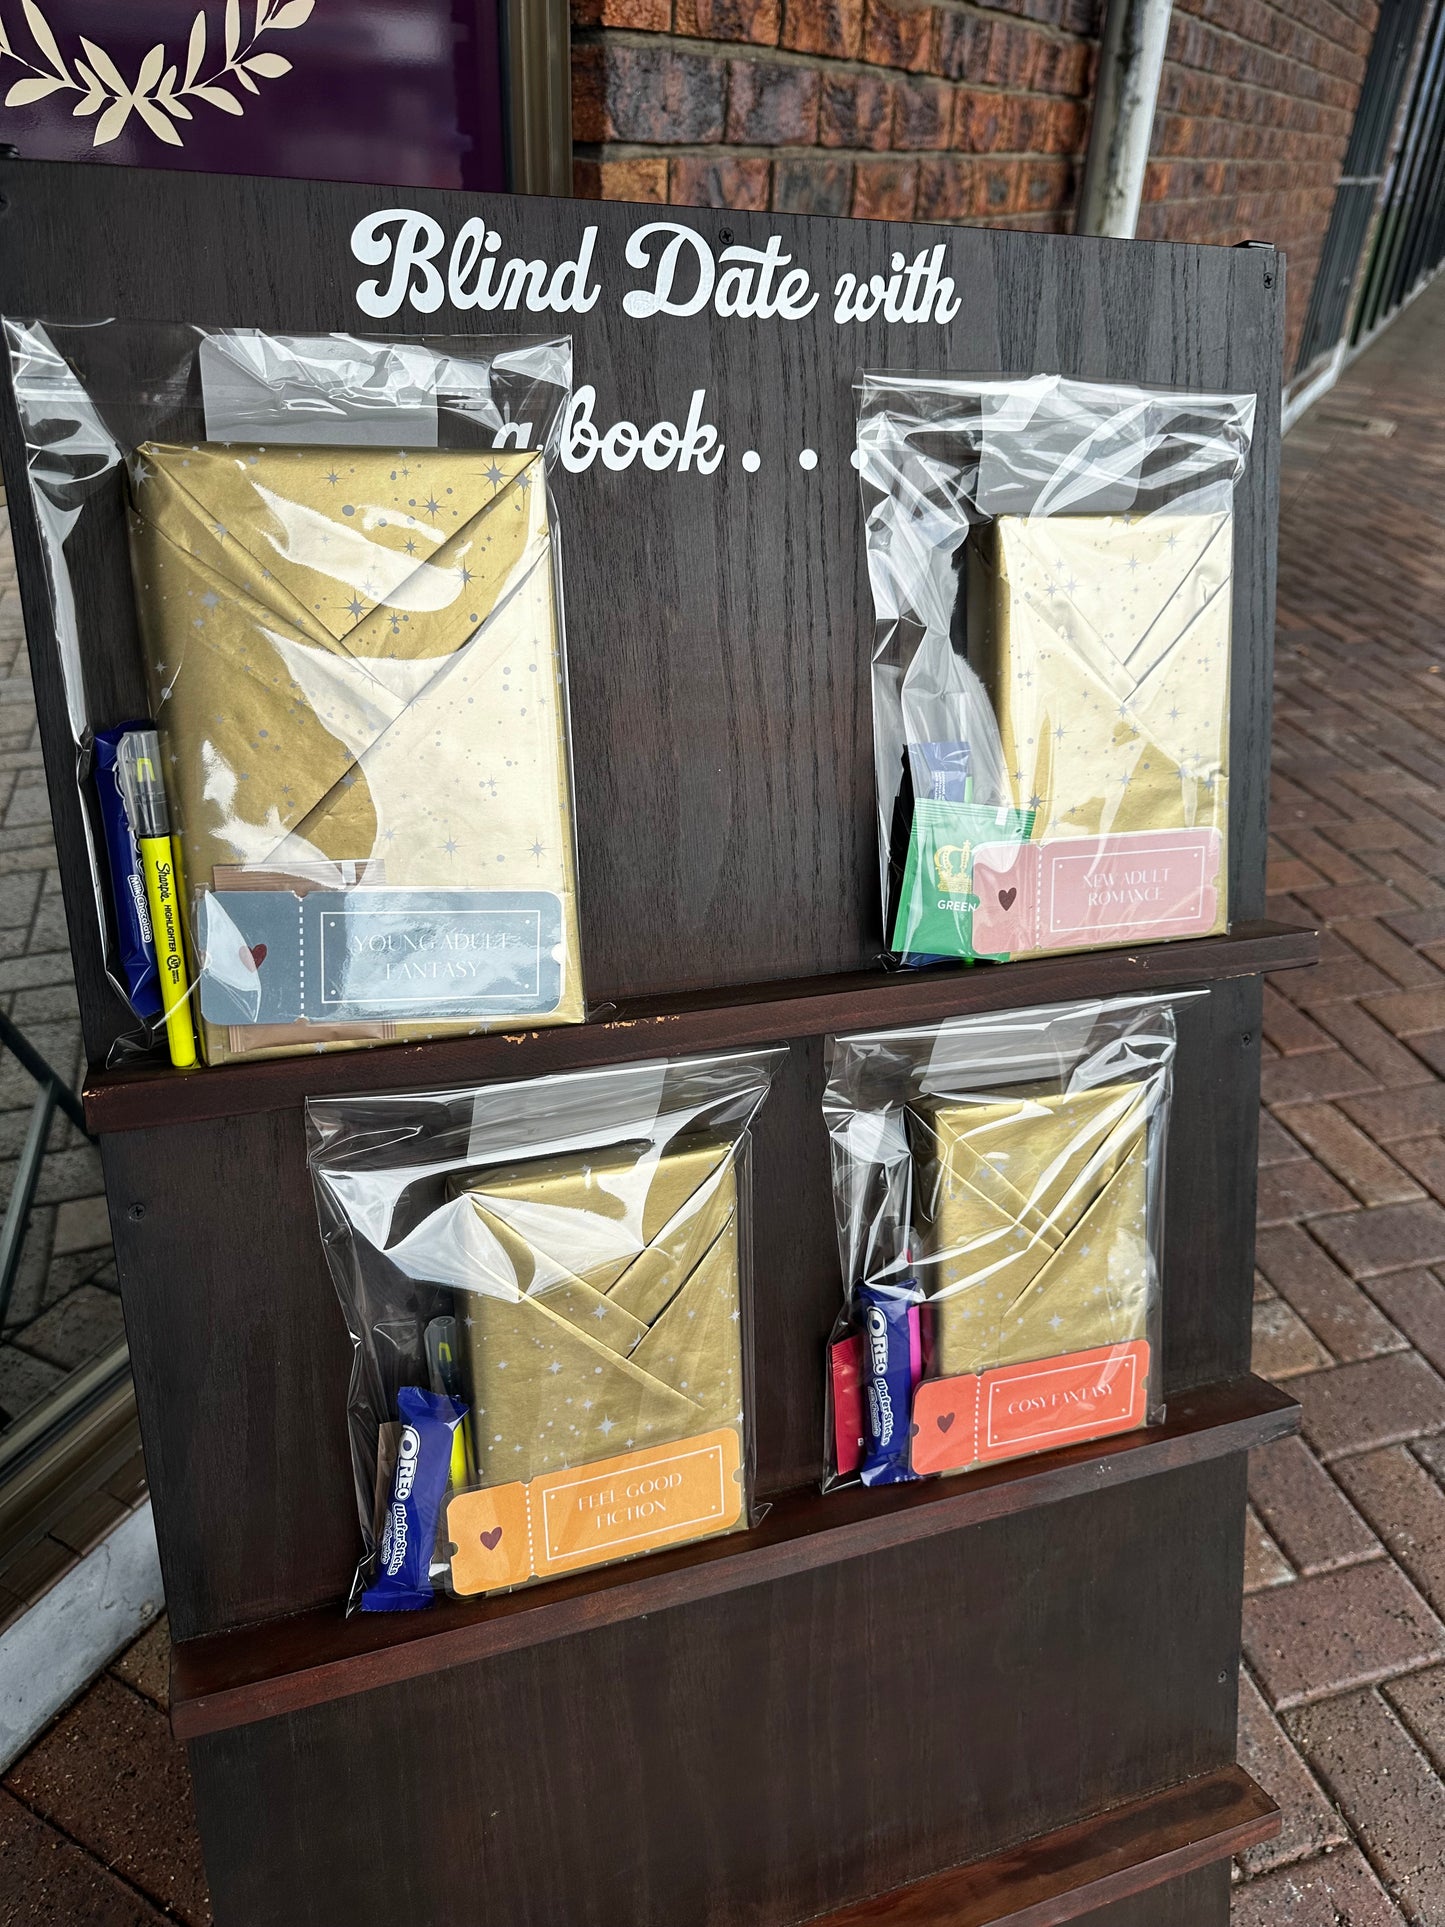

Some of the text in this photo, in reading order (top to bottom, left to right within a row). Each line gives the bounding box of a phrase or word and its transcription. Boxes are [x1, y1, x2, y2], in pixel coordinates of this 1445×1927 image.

[351, 209, 962, 325] Blind Date with
[560, 384, 725, 475] book
[1083, 867, 1171, 888] NEW ADULT
[129, 875, 151, 942] Milk Chocolate
[155, 860, 171, 901] Sharpie
[164, 904, 177, 952] HIGHLIGHTER
[937, 899, 977, 912] GREEN
[1088, 886, 1165, 906] ROMANCE
[354, 932, 511, 951] YOUNG ADULT
[386, 961, 481, 979] FANTASY
[867, 1306, 888, 1375] OREO
[1008, 1383, 1114, 1415] COSY FANTASY
[395, 1425, 421, 1500] OREO
[597, 1497, 667, 1528] FICTION
